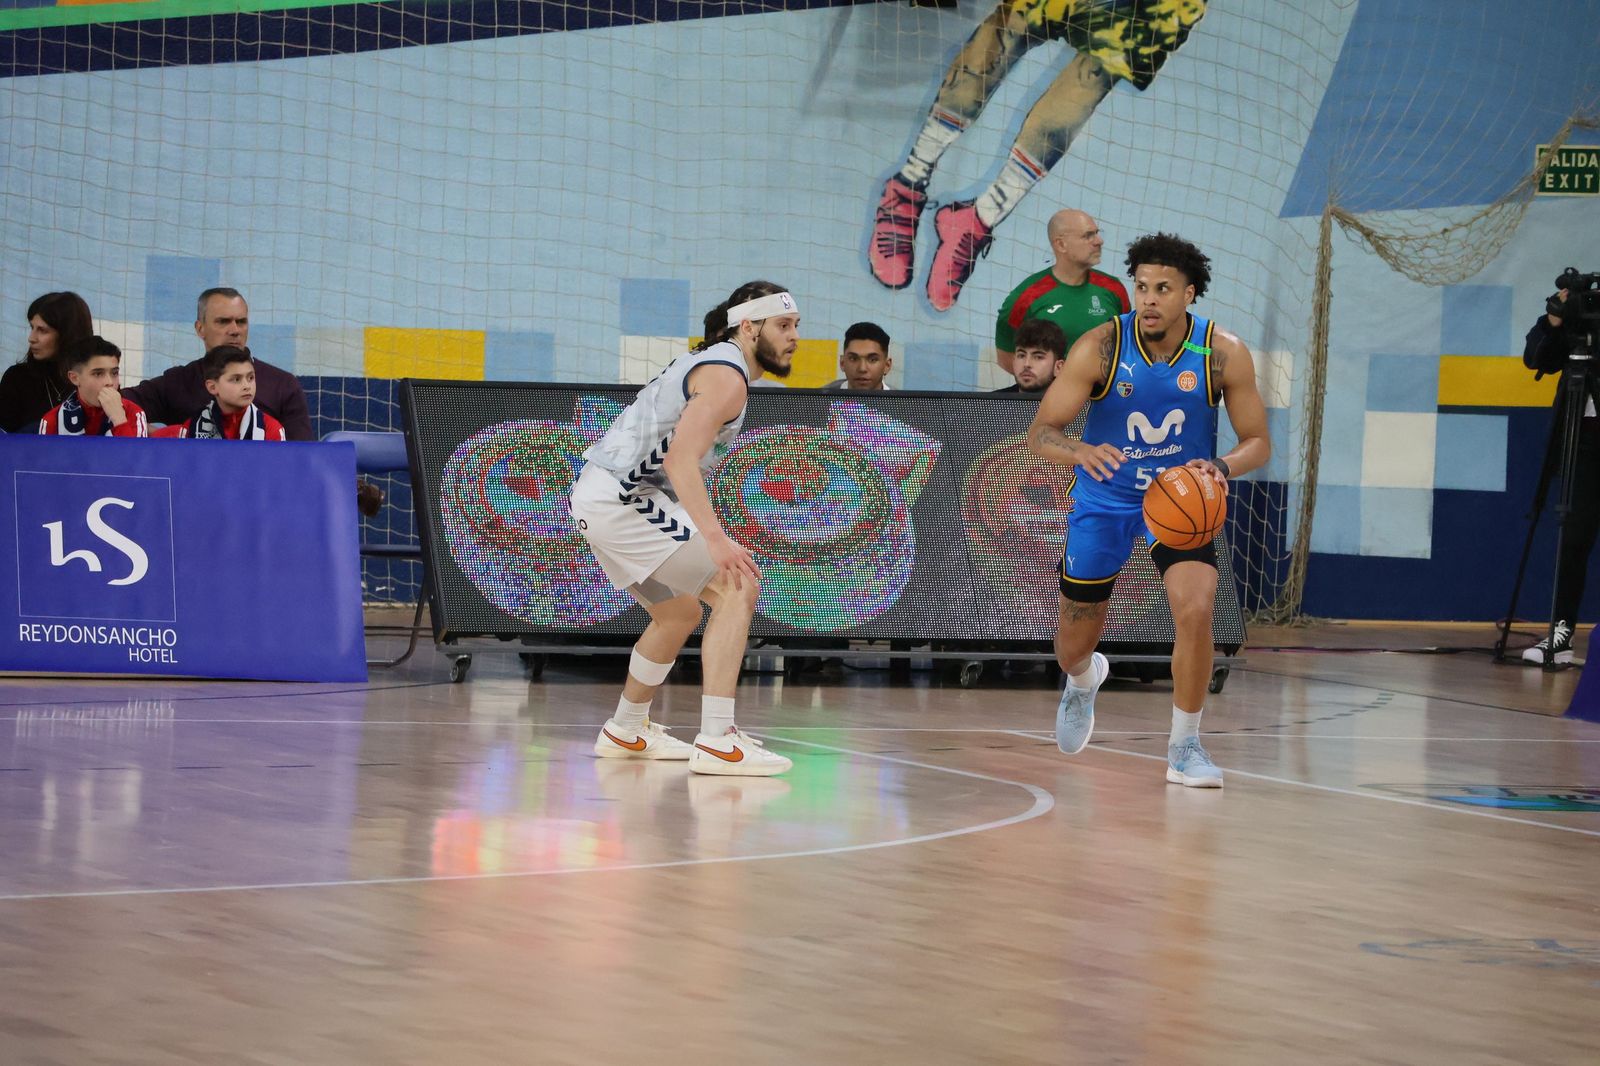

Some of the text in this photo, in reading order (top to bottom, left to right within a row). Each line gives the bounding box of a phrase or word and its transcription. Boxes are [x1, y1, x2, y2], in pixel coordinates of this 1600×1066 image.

[1541, 152, 1599, 168] ALIDA
[1545, 173, 1594, 189] EXIT
[1122, 443, 1182, 460] Estudiantes
[1134, 466, 1167, 491] 5
[18, 623, 178, 647] REYDONSANCHO
[128, 647, 179, 664] HOTEL
